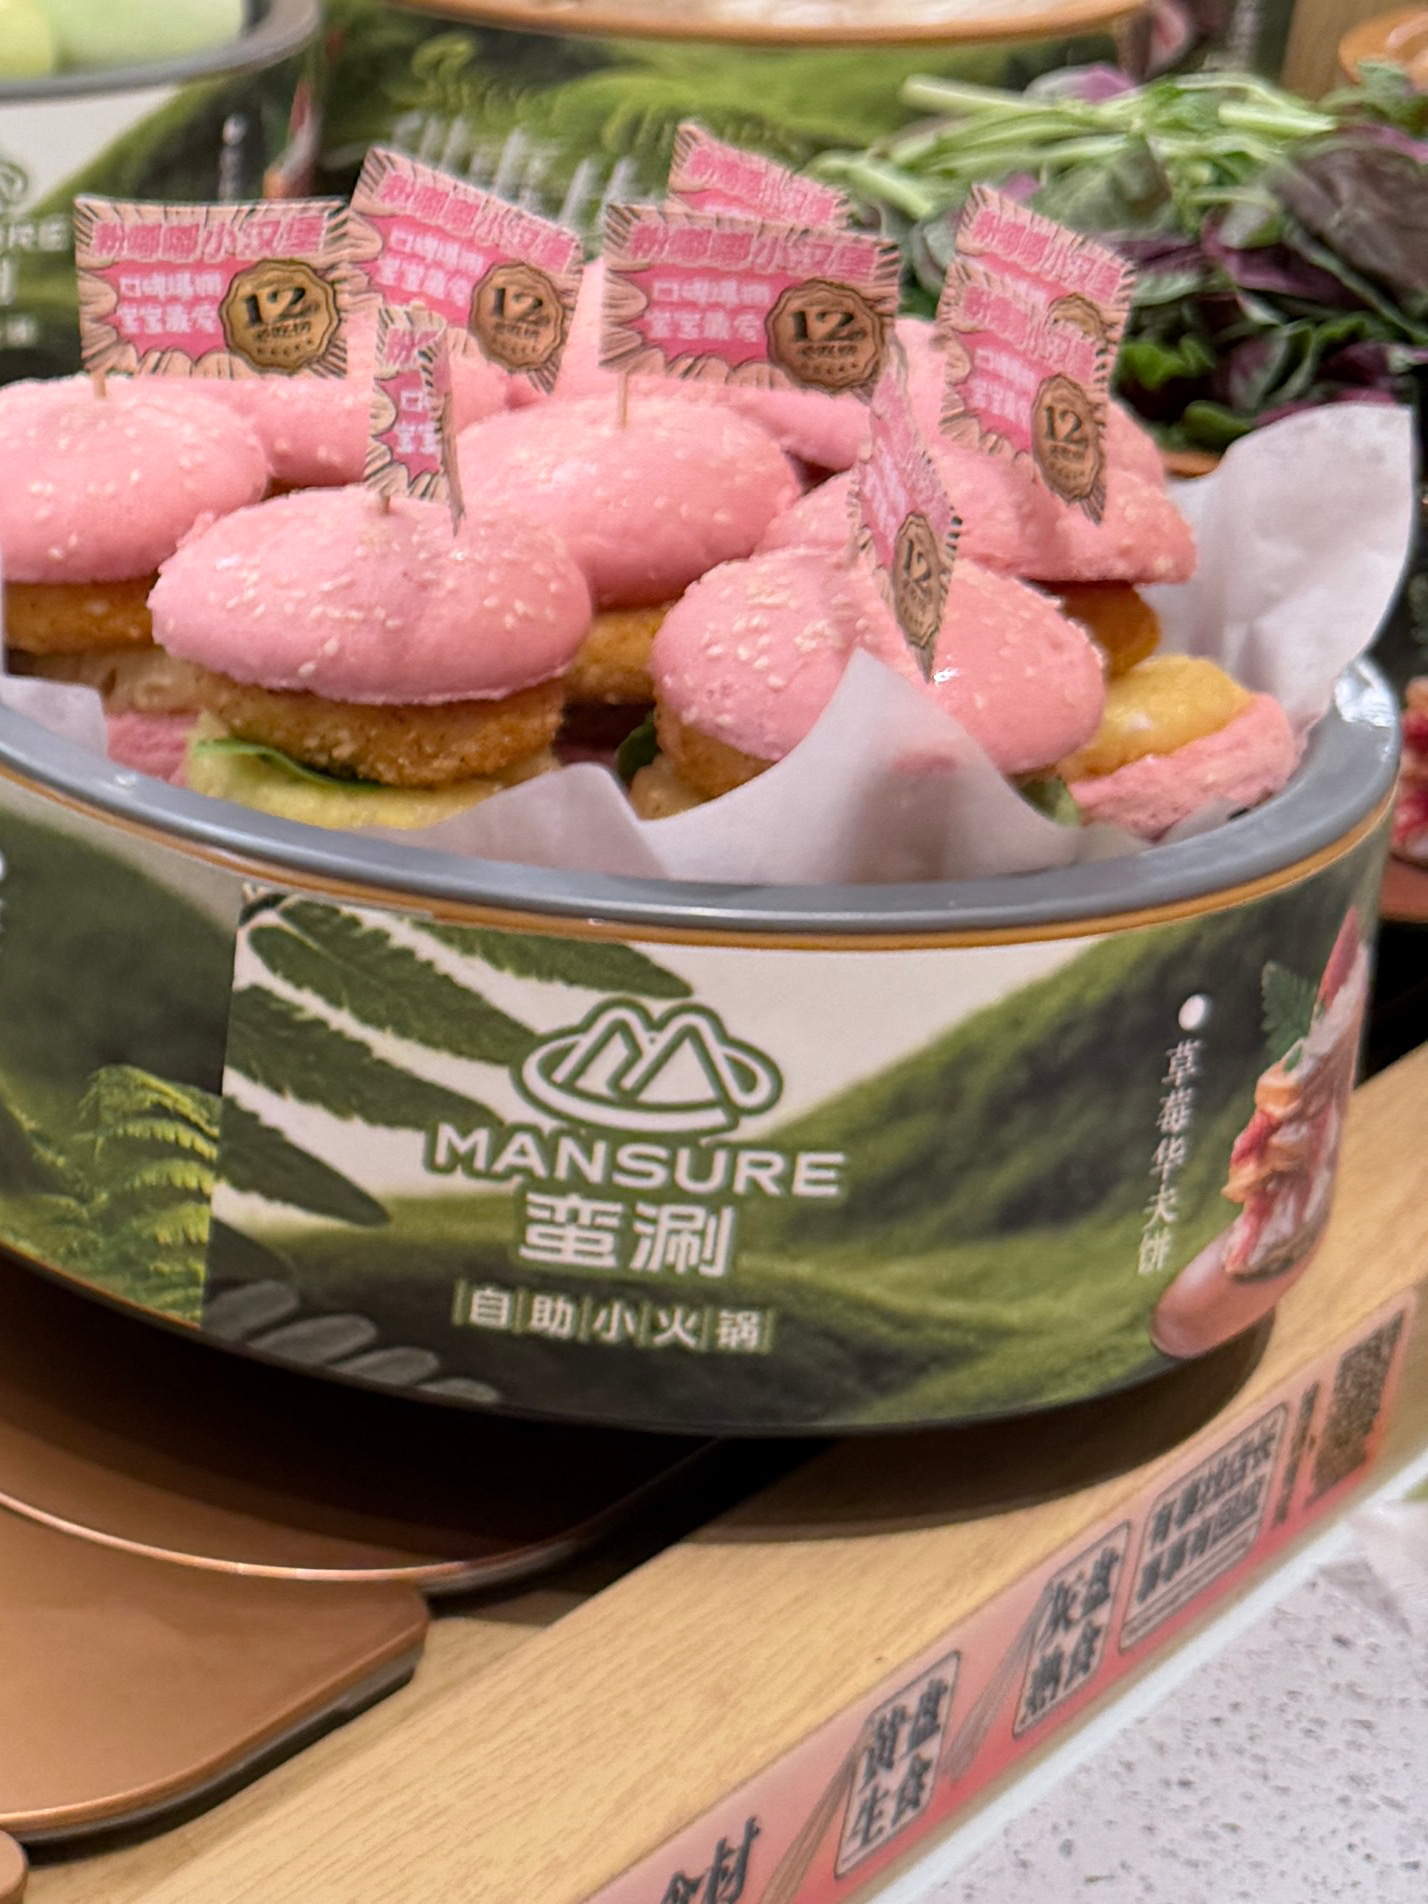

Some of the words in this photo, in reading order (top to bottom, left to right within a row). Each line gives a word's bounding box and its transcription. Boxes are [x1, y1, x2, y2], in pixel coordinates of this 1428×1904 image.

[244, 286, 321, 328] 12
[791, 310, 869, 343] 12
[1043, 406, 1084, 448] 12
[433, 1121, 845, 1197] MANSURE
[519, 1191, 736, 1278] 蛮涮
[469, 1286, 762, 1354] 自助小火锅
